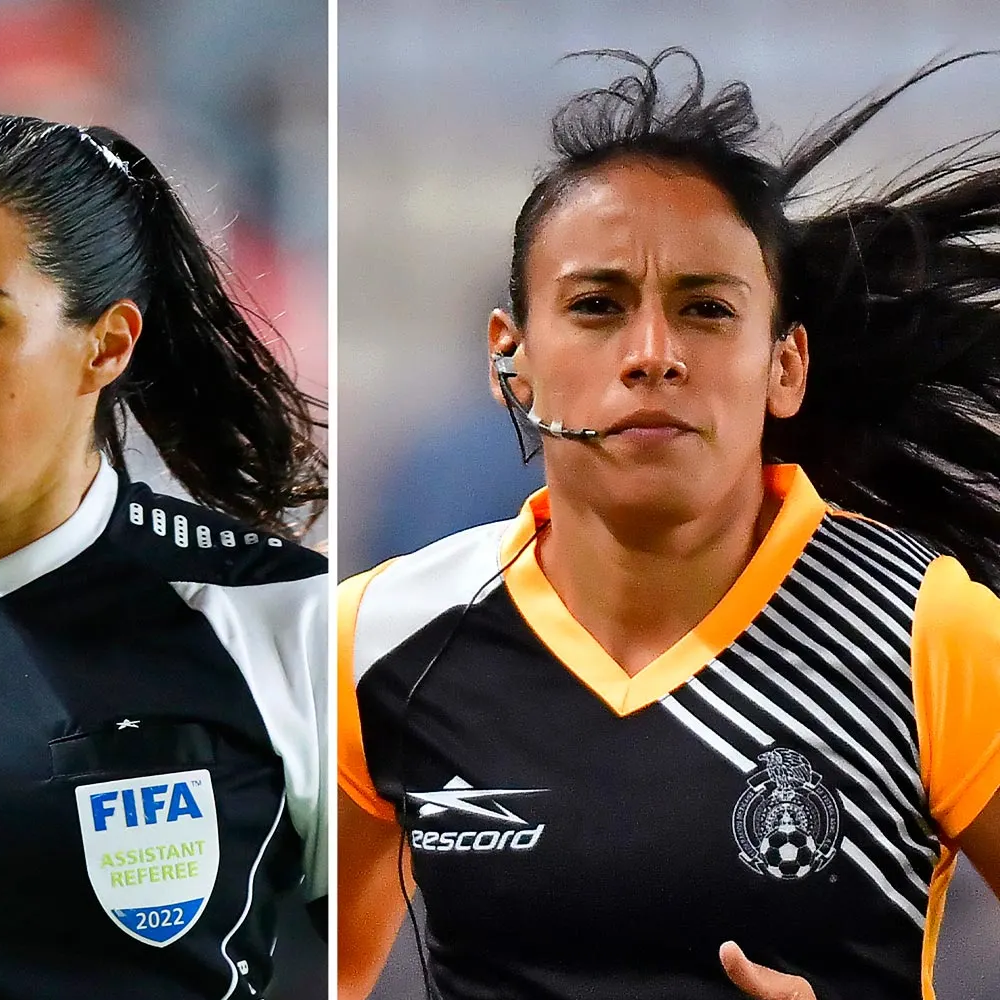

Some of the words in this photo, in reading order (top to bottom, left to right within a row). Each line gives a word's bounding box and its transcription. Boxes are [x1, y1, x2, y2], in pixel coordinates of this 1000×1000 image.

[90, 782, 203, 832] FIFA
[101, 840, 206, 868] ASSISTANT
[110, 861, 199, 888] REFEREE
[136, 908, 185, 930] 2022
